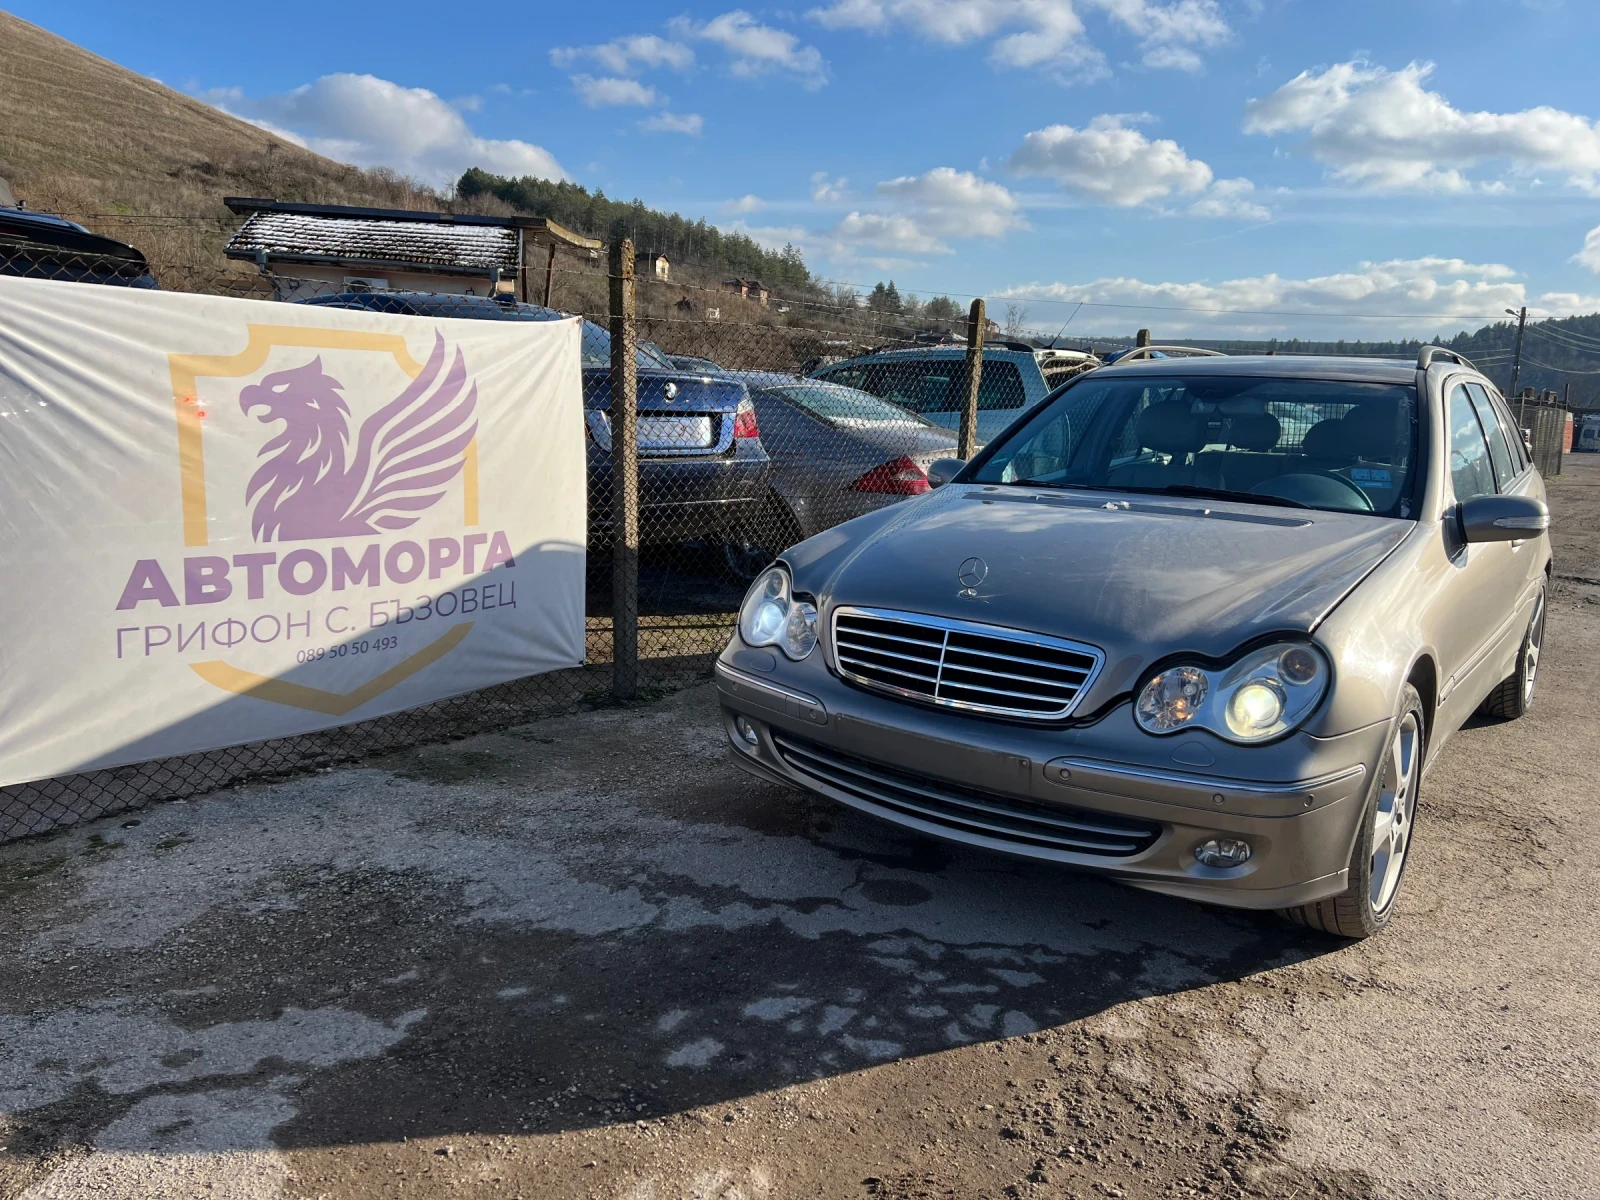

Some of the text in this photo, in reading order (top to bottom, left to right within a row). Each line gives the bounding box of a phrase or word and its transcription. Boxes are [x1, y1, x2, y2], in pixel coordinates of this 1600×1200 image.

[115, 530, 516, 610] АВТОМОРГА
[116, 581, 517, 659] ГРИФОН С. БЪЗОВЕЦ
[296, 636, 398, 664] 089 50 50 493
